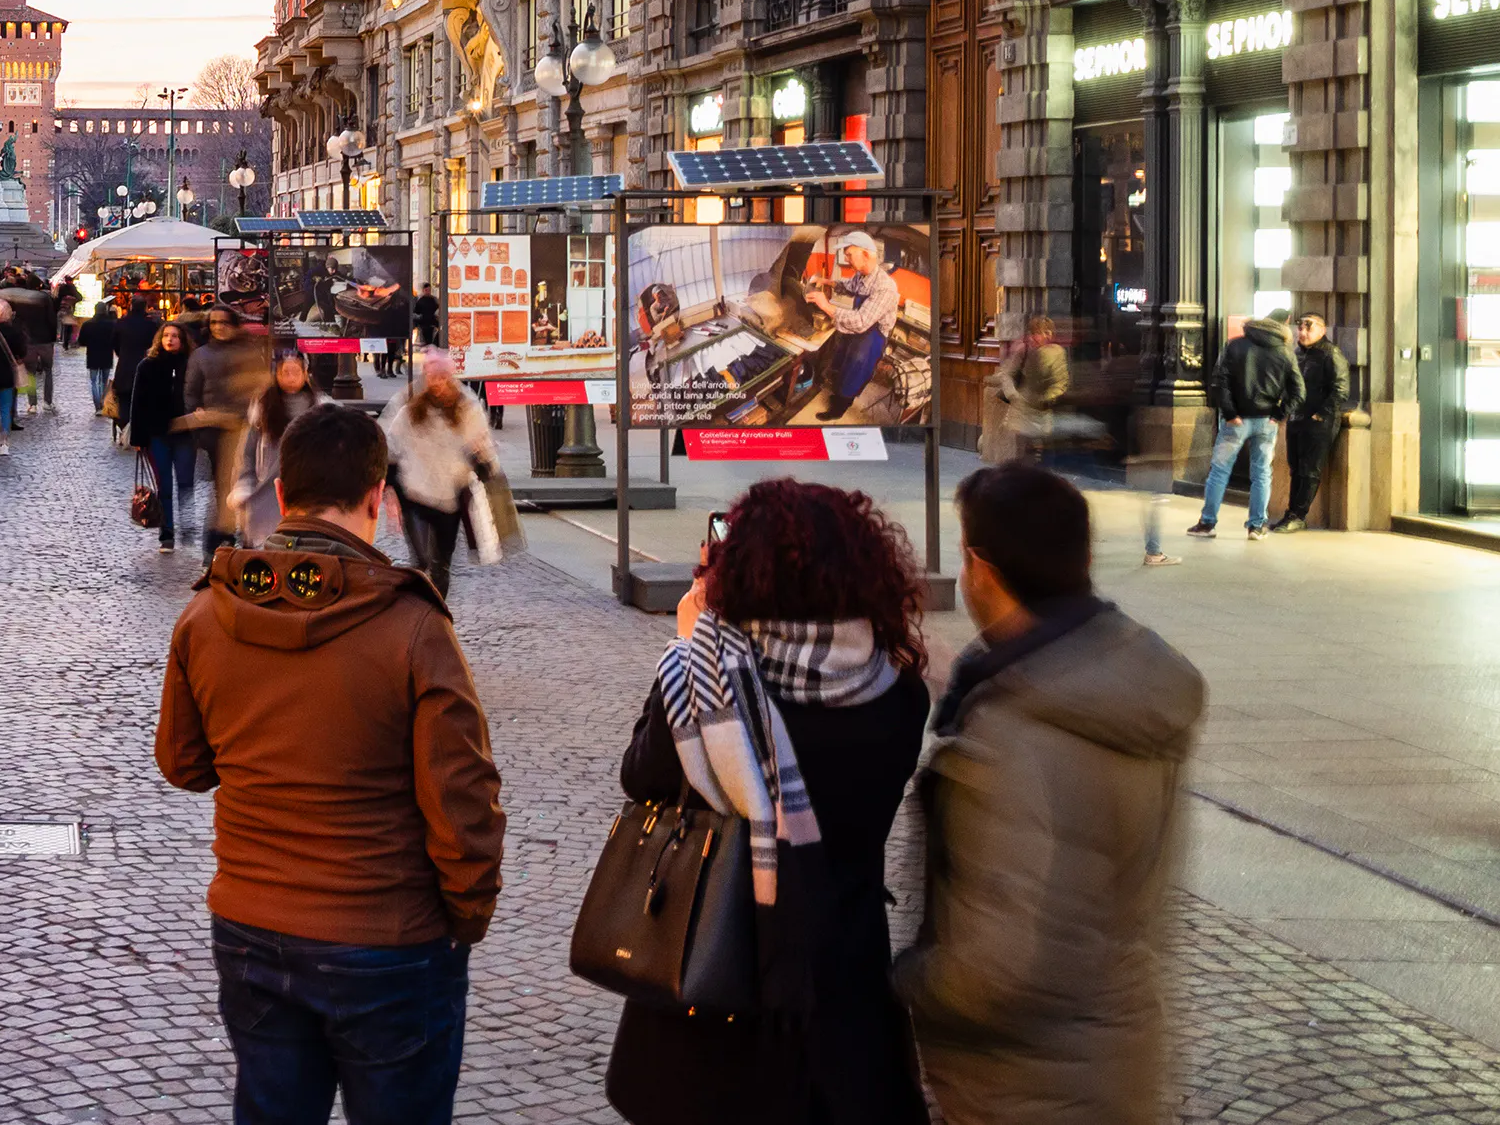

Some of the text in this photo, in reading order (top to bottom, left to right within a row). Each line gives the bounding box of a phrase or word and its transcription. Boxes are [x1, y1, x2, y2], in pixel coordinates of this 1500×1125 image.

[663, 381, 690, 391] poesia
[691, 380, 740, 389] dell'arrotino
[631, 391, 747, 401] che guida la lama sulla mola
[631, 401, 717, 412] come il pittore guida
[631, 411, 712, 421] il pennello sulla tela
[741, 431, 774, 439] Arrotino
